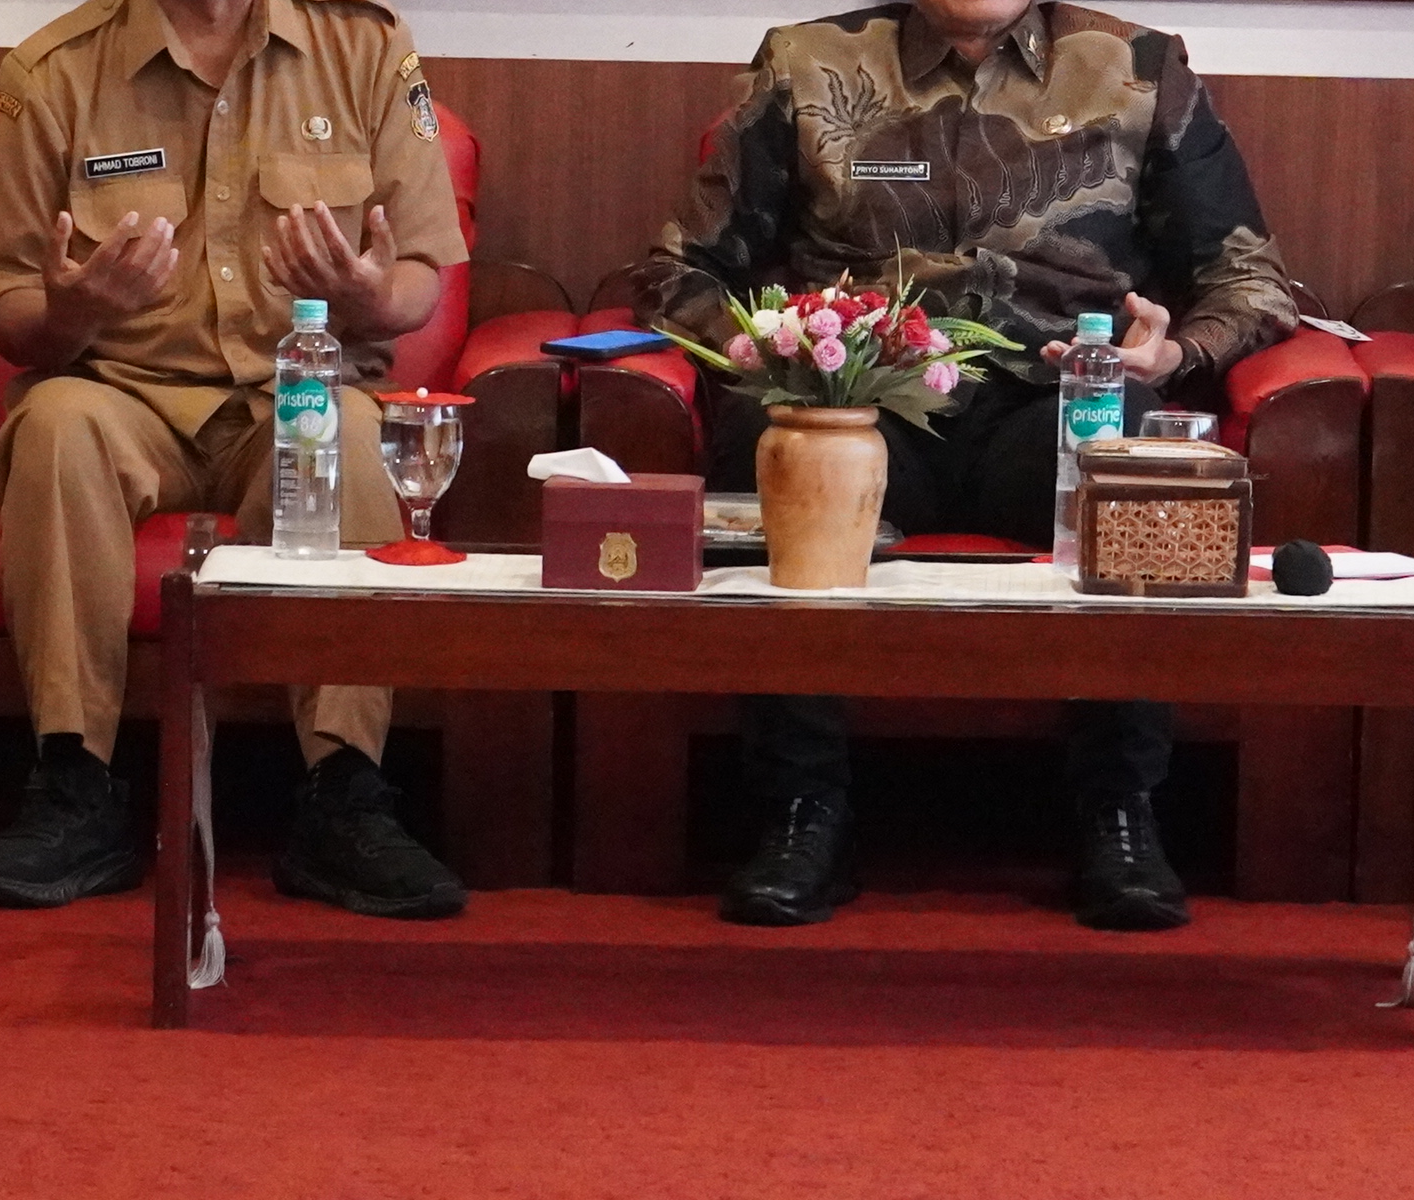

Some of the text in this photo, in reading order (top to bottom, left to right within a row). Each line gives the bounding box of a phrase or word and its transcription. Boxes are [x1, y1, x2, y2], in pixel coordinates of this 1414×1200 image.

[93, 154, 158, 172] AHMAD TOBRONI
[855, 166, 878, 175] PRIYO
[277, 392, 325, 409] pristine
[1073, 407, 1121, 424] pristine
